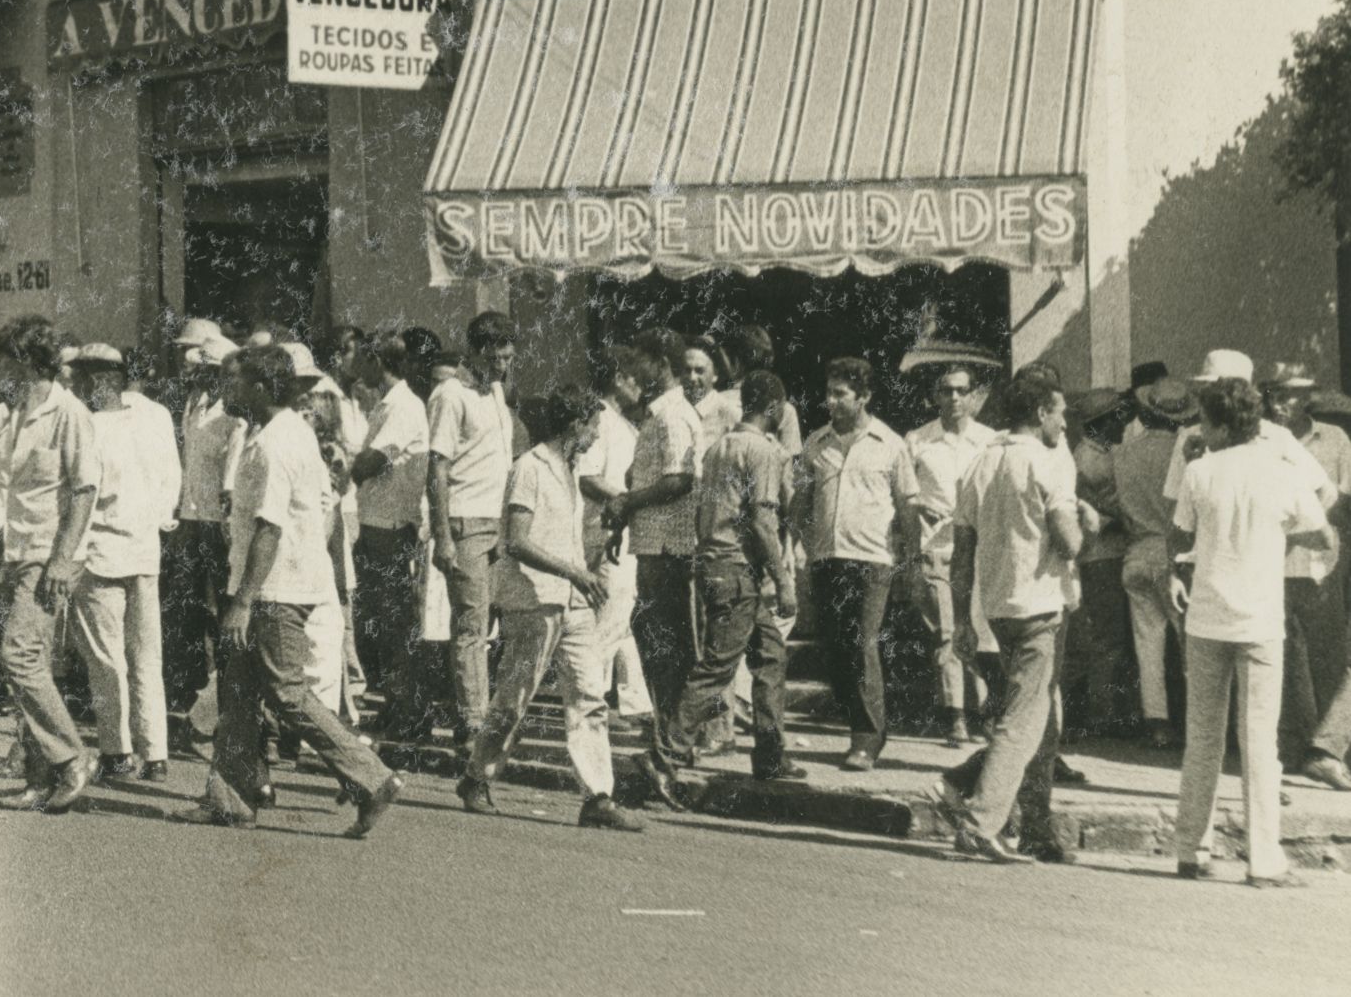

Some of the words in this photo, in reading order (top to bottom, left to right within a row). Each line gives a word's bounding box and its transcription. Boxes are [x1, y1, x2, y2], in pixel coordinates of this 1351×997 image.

[53, 11, 84, 57] A
[311, 25, 407, 51] TECIDOS
[420, 33, 433, 53] E
[299, 50, 375, 75] ROUPAS
[438, 197, 688, 260] SEMPRE
[715, 185, 1077, 253] NOVIDADES
